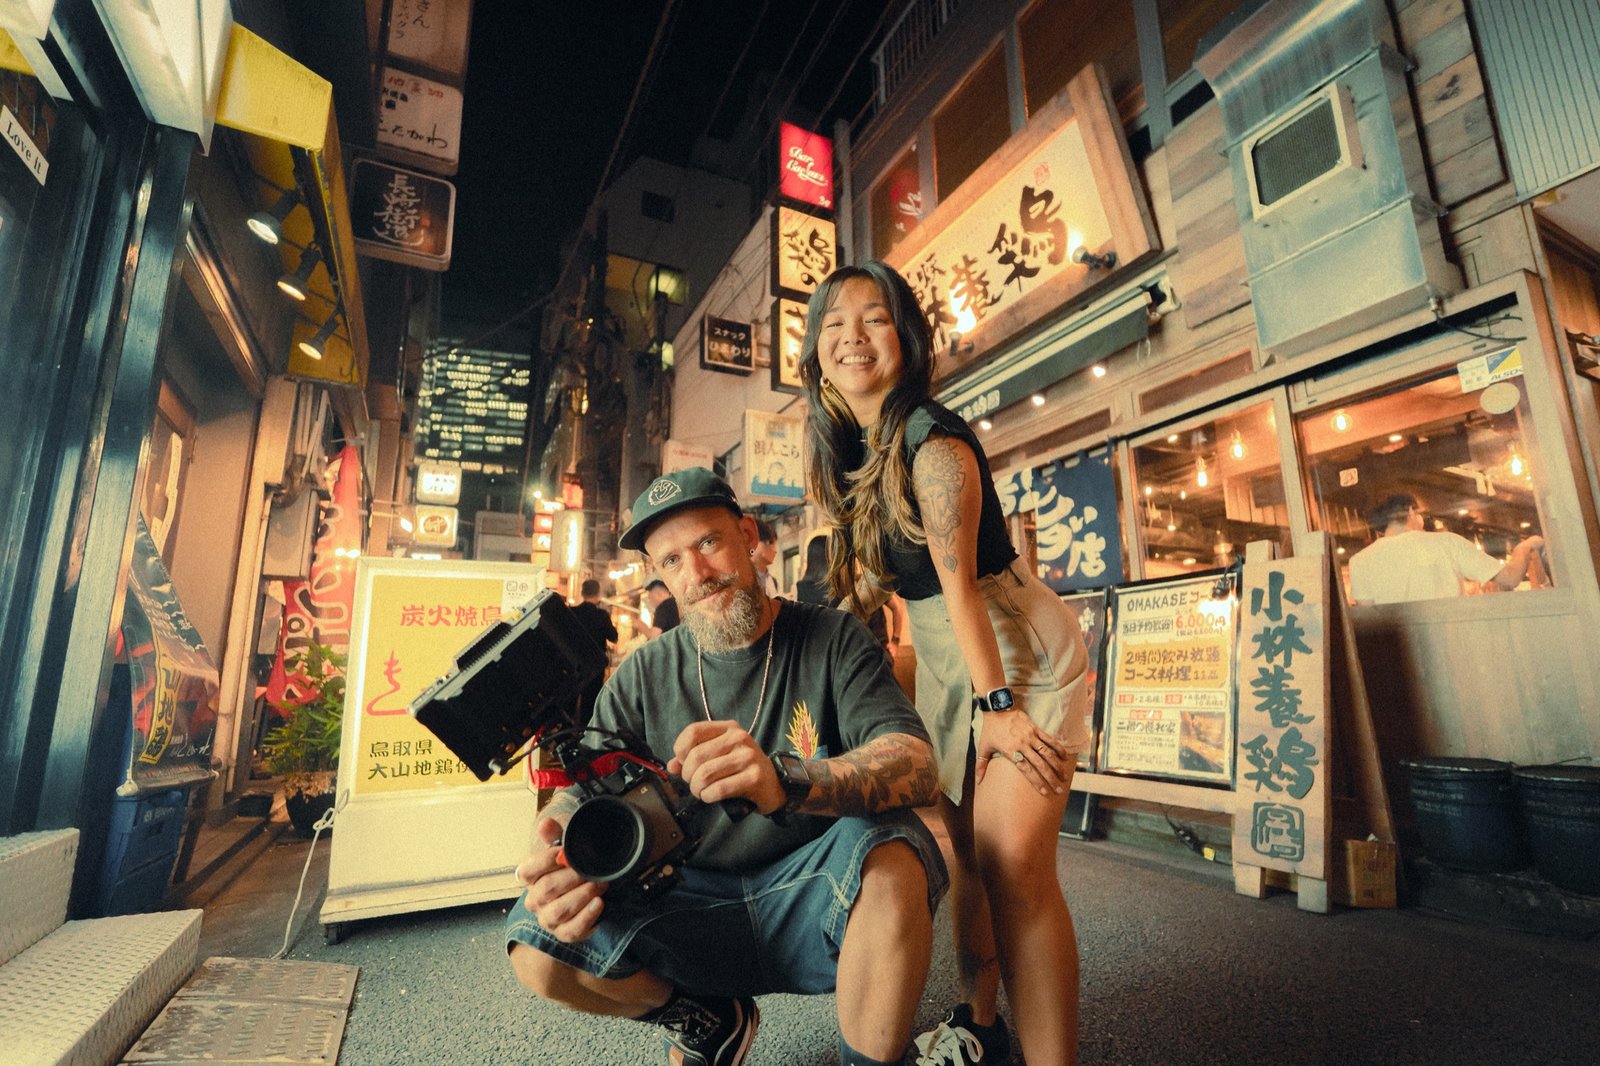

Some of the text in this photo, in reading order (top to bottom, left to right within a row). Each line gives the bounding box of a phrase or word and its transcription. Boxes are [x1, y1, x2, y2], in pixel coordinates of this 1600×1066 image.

[7, 121, 41, 174] Love It
[400, 604, 502, 627] 炭火焼鳥
[1124, 666, 1192, 683] コース料理
[369, 739, 432, 758] 鳥取県
